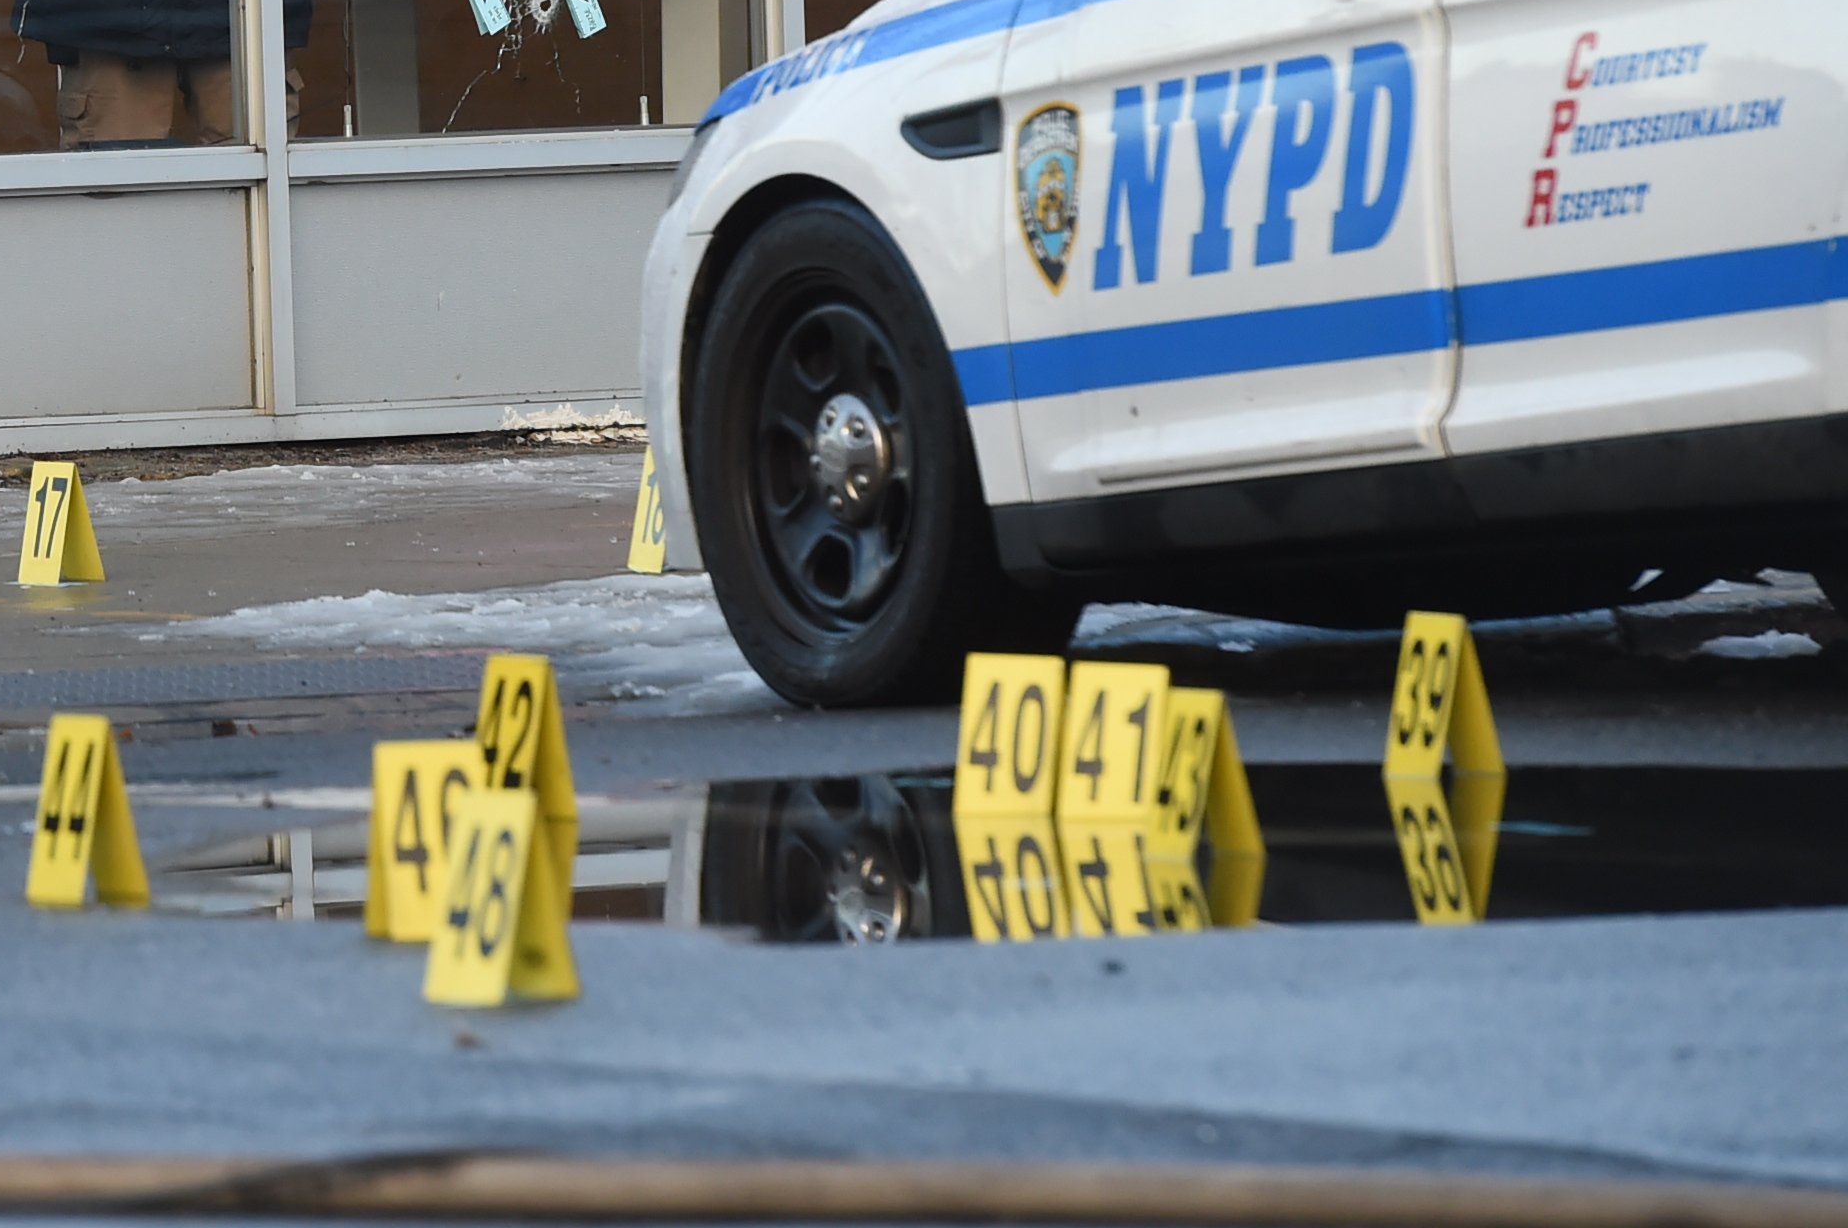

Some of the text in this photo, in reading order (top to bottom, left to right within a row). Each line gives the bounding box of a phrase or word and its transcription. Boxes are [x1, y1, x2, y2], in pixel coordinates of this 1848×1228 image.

[1091, 41, 1416, 291] NYPD
[33, 476, 69, 560] 17
[480, 677, 533, 789] 42
[968, 680, 1048, 794] 40
[1073, 689, 1153, 804] 41
[1398, 637, 1450, 749] 39
[43, 738, 95, 863] 44
